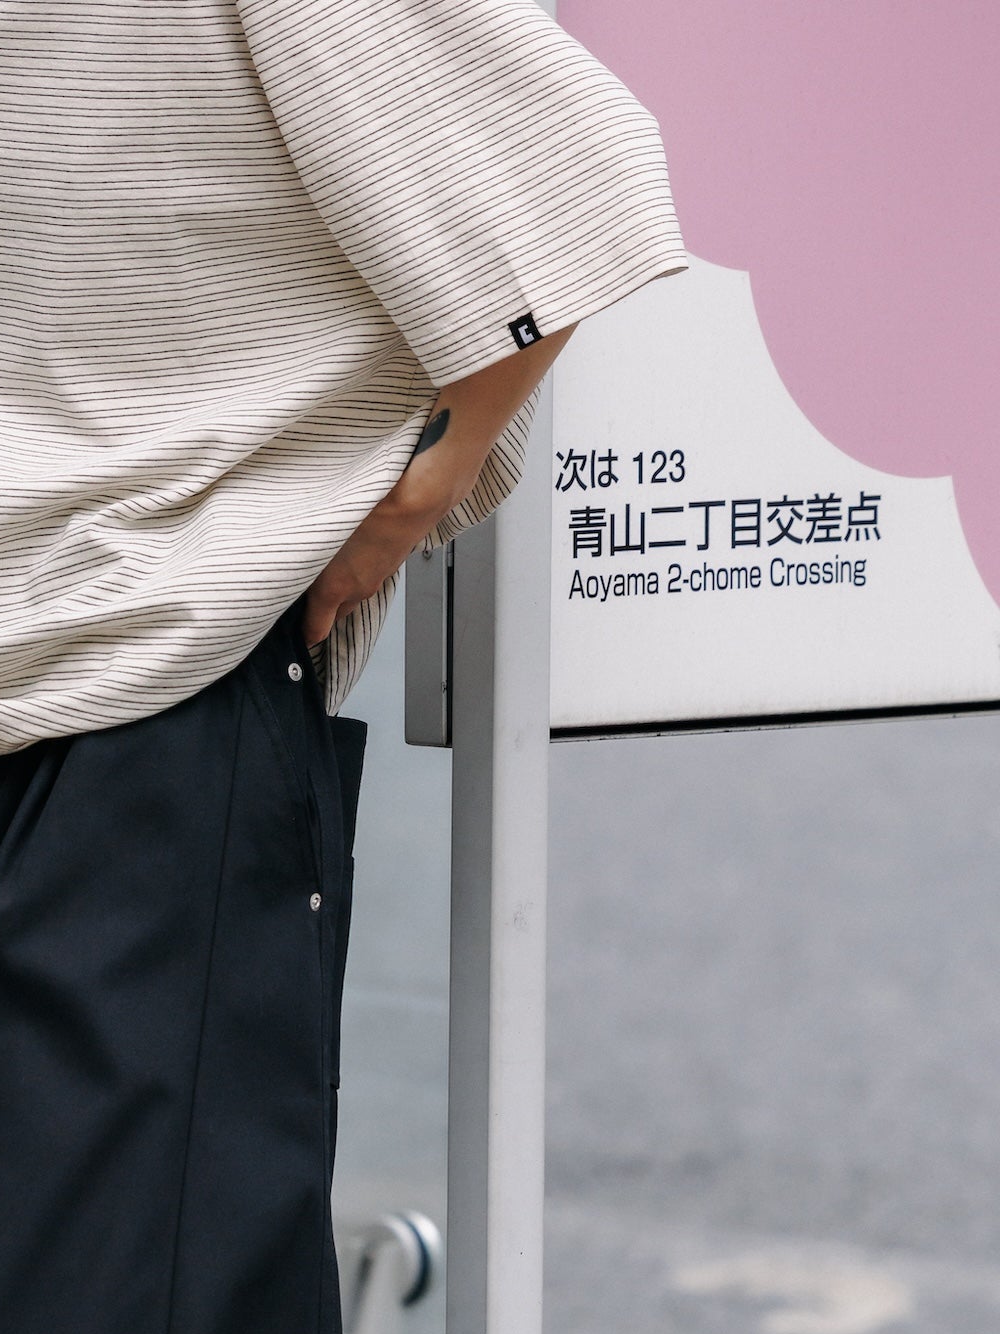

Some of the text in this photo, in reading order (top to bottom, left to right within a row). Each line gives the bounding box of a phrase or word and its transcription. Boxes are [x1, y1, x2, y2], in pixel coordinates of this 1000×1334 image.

[555, 448, 686, 492] 次は 123
[568, 491, 882, 559] 青山二丁目交差点
[568, 554, 867, 602] Aoyama 2-chome Crossing
